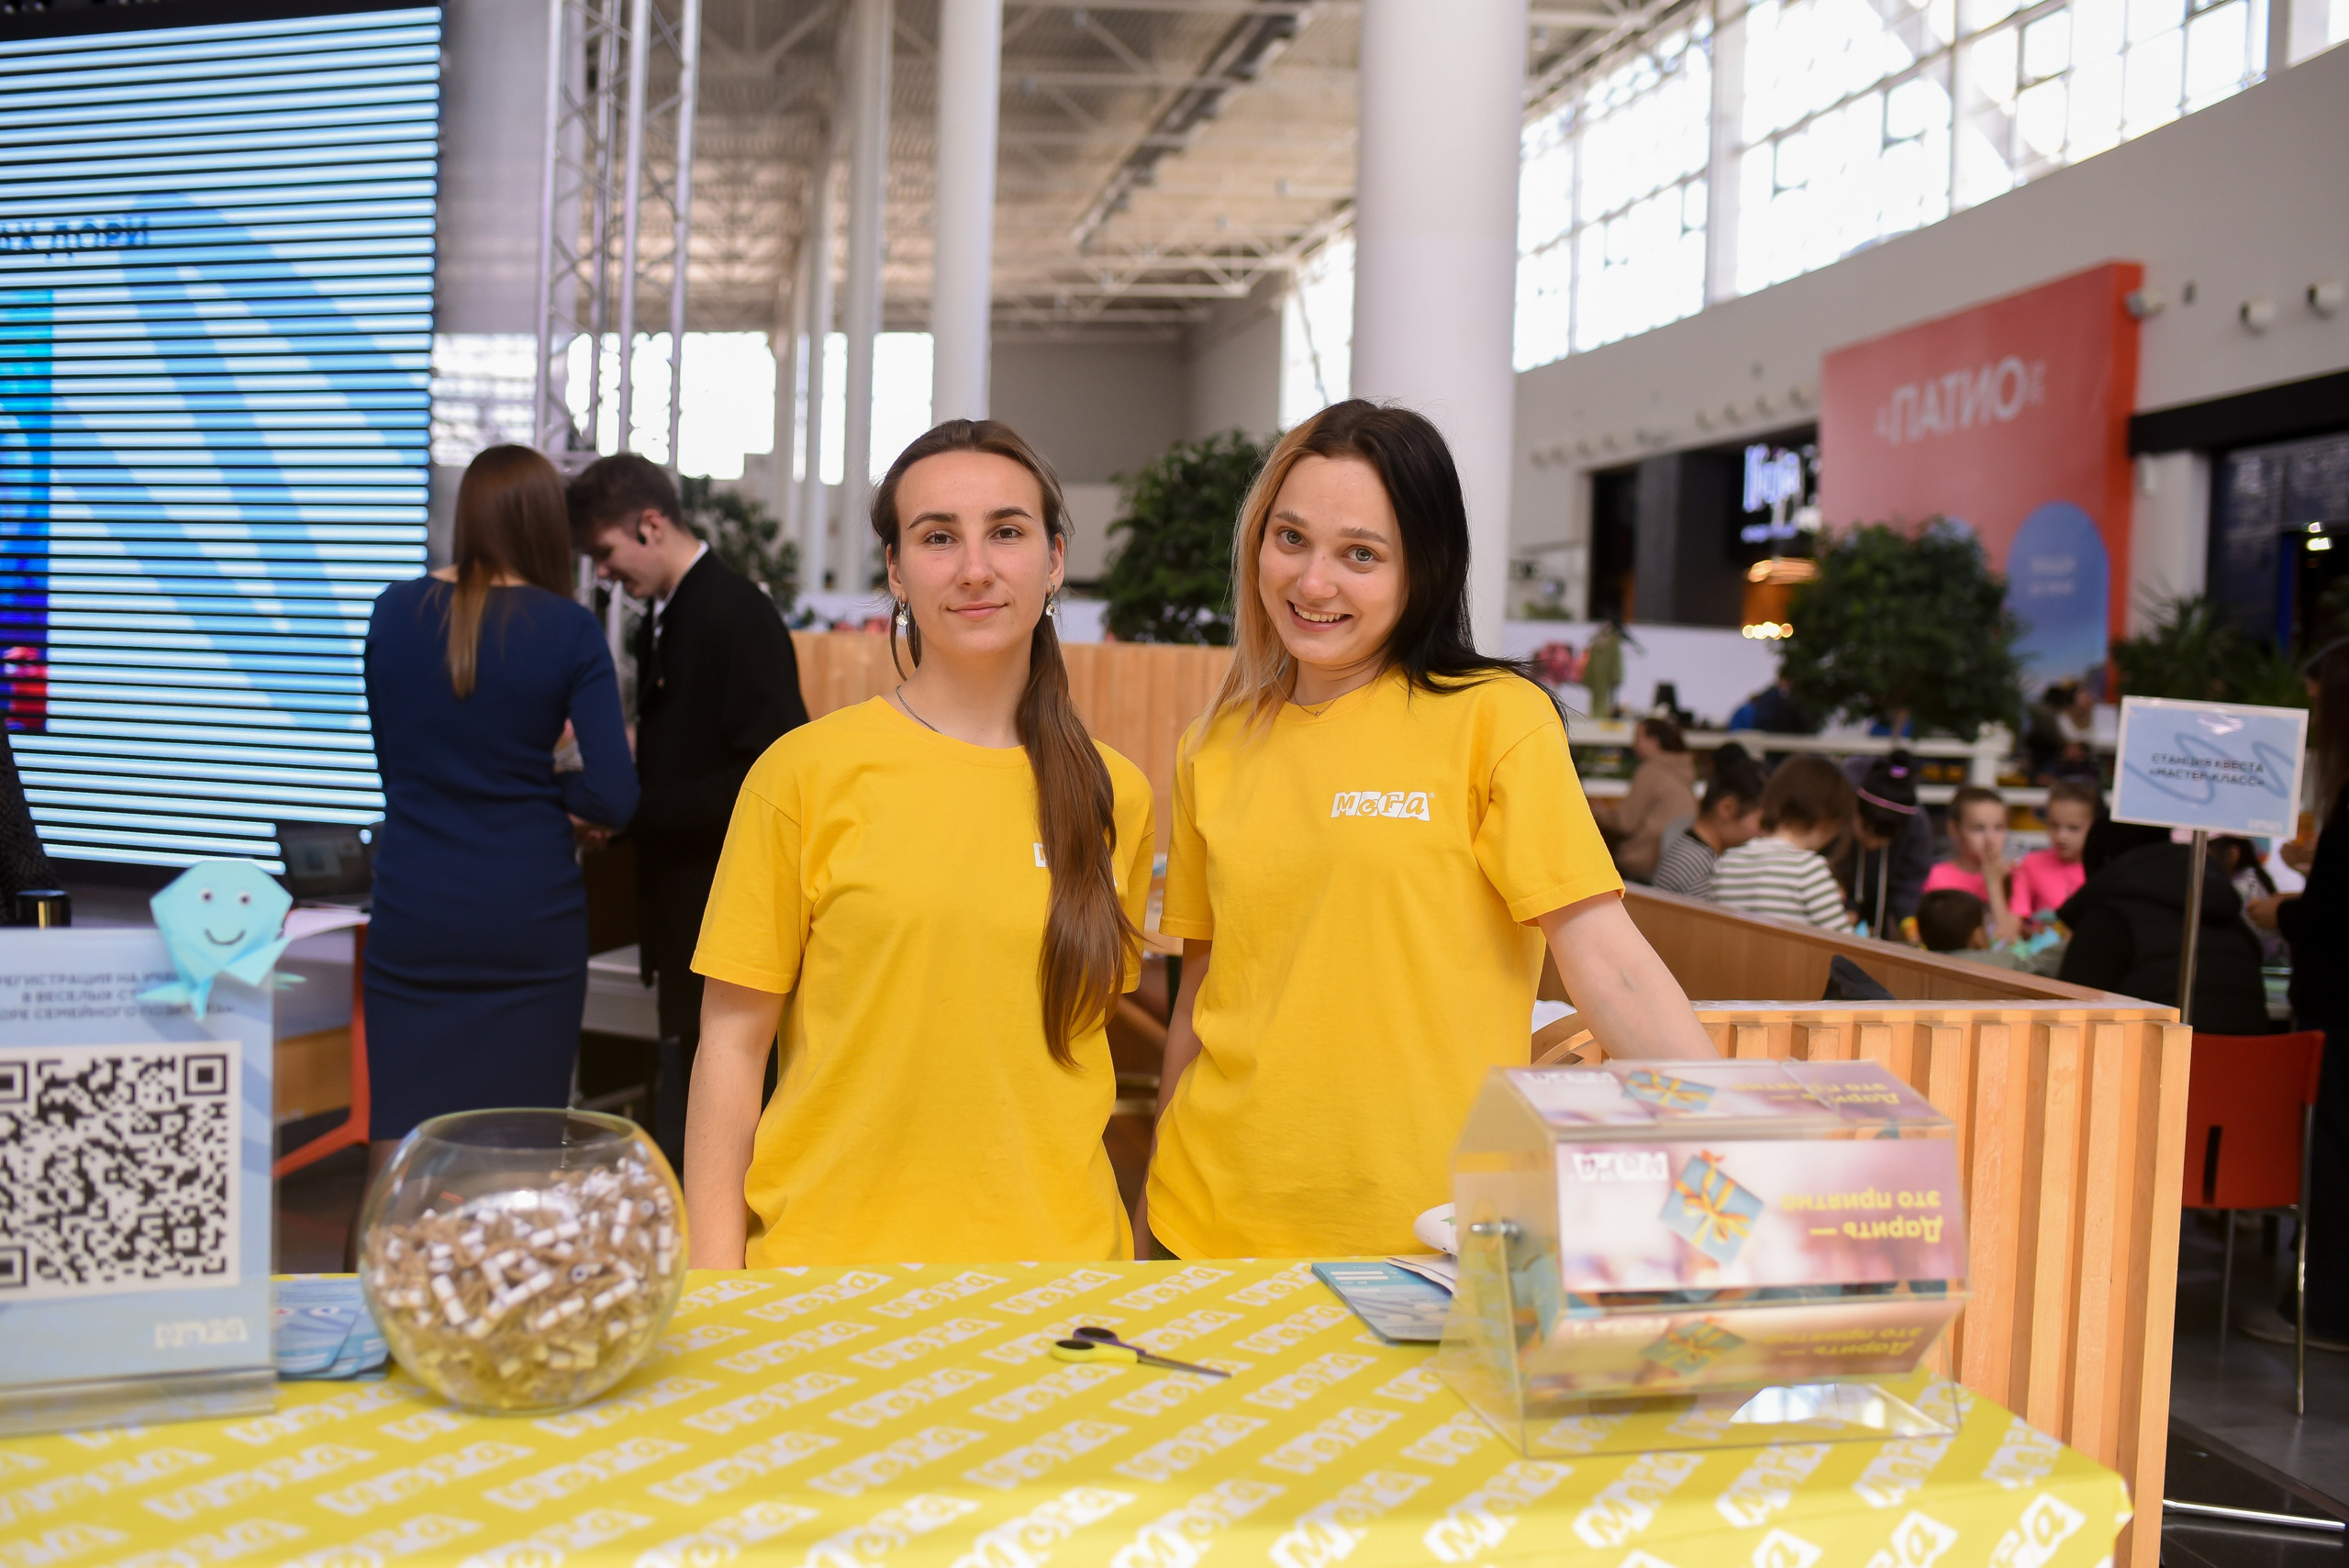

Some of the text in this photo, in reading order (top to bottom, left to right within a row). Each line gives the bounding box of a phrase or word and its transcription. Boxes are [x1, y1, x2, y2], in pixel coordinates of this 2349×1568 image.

[2152, 753, 2264, 773] СТАНЦИЯ КВЕСТА
[1781, 1185, 1942, 1212] это приятно
[1842, 1215, 1944, 1244] Дарить
